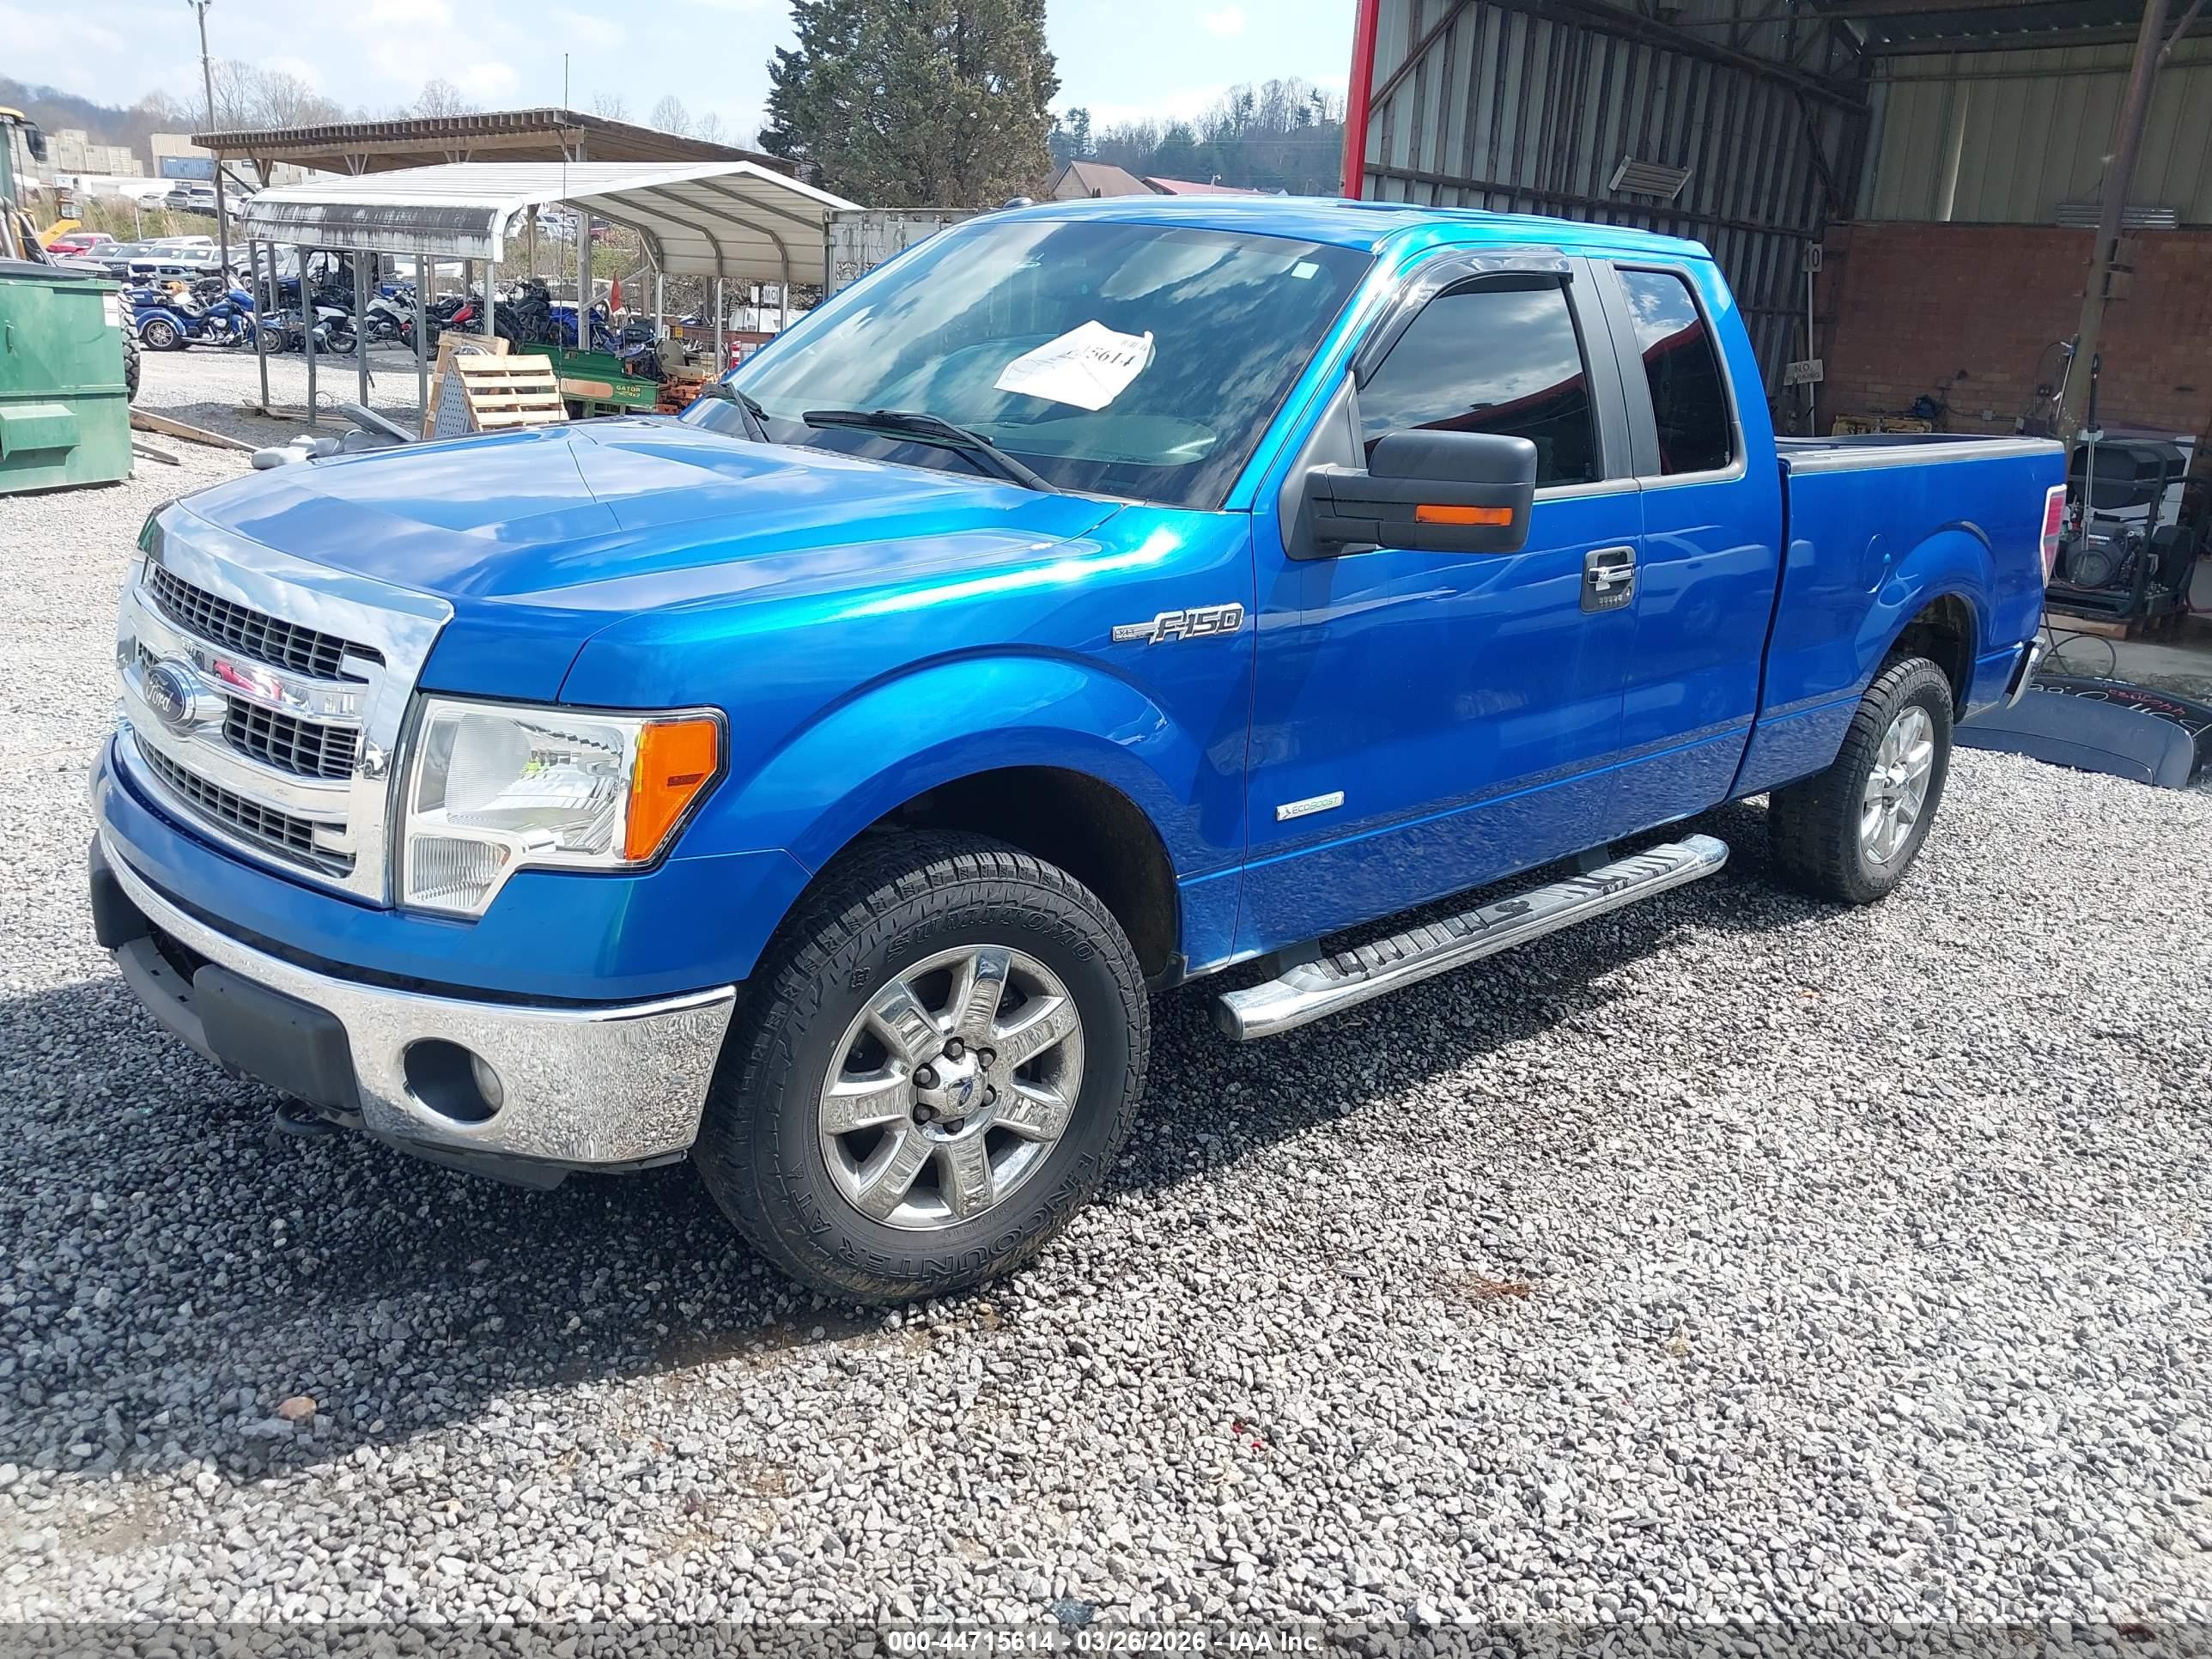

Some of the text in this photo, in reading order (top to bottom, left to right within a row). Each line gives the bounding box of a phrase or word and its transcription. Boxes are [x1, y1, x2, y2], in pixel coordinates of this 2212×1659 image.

[1155, 606, 1244, 642] F-150
[145, 672, 174, 713] Ford
[1291, 796, 1340, 814] ECOBOOST
[887, 905, 1097, 963] SUMITOMO
